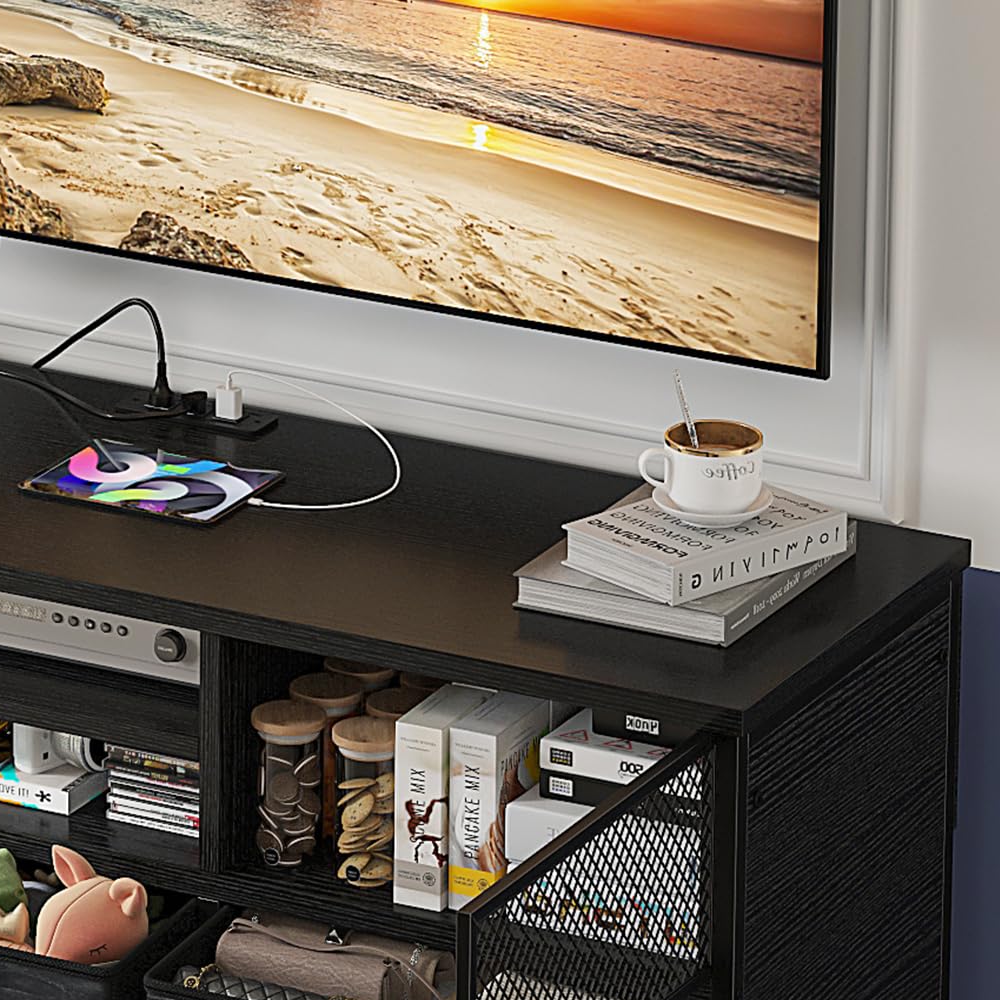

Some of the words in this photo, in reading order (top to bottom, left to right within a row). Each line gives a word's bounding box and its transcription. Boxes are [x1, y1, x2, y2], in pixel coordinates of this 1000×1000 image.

[410, 768, 426, 795] MIX
[463, 765, 481, 792] MIX
[18, 787, 30, 798] IT!
[463, 796, 480, 861] PANCAKE
